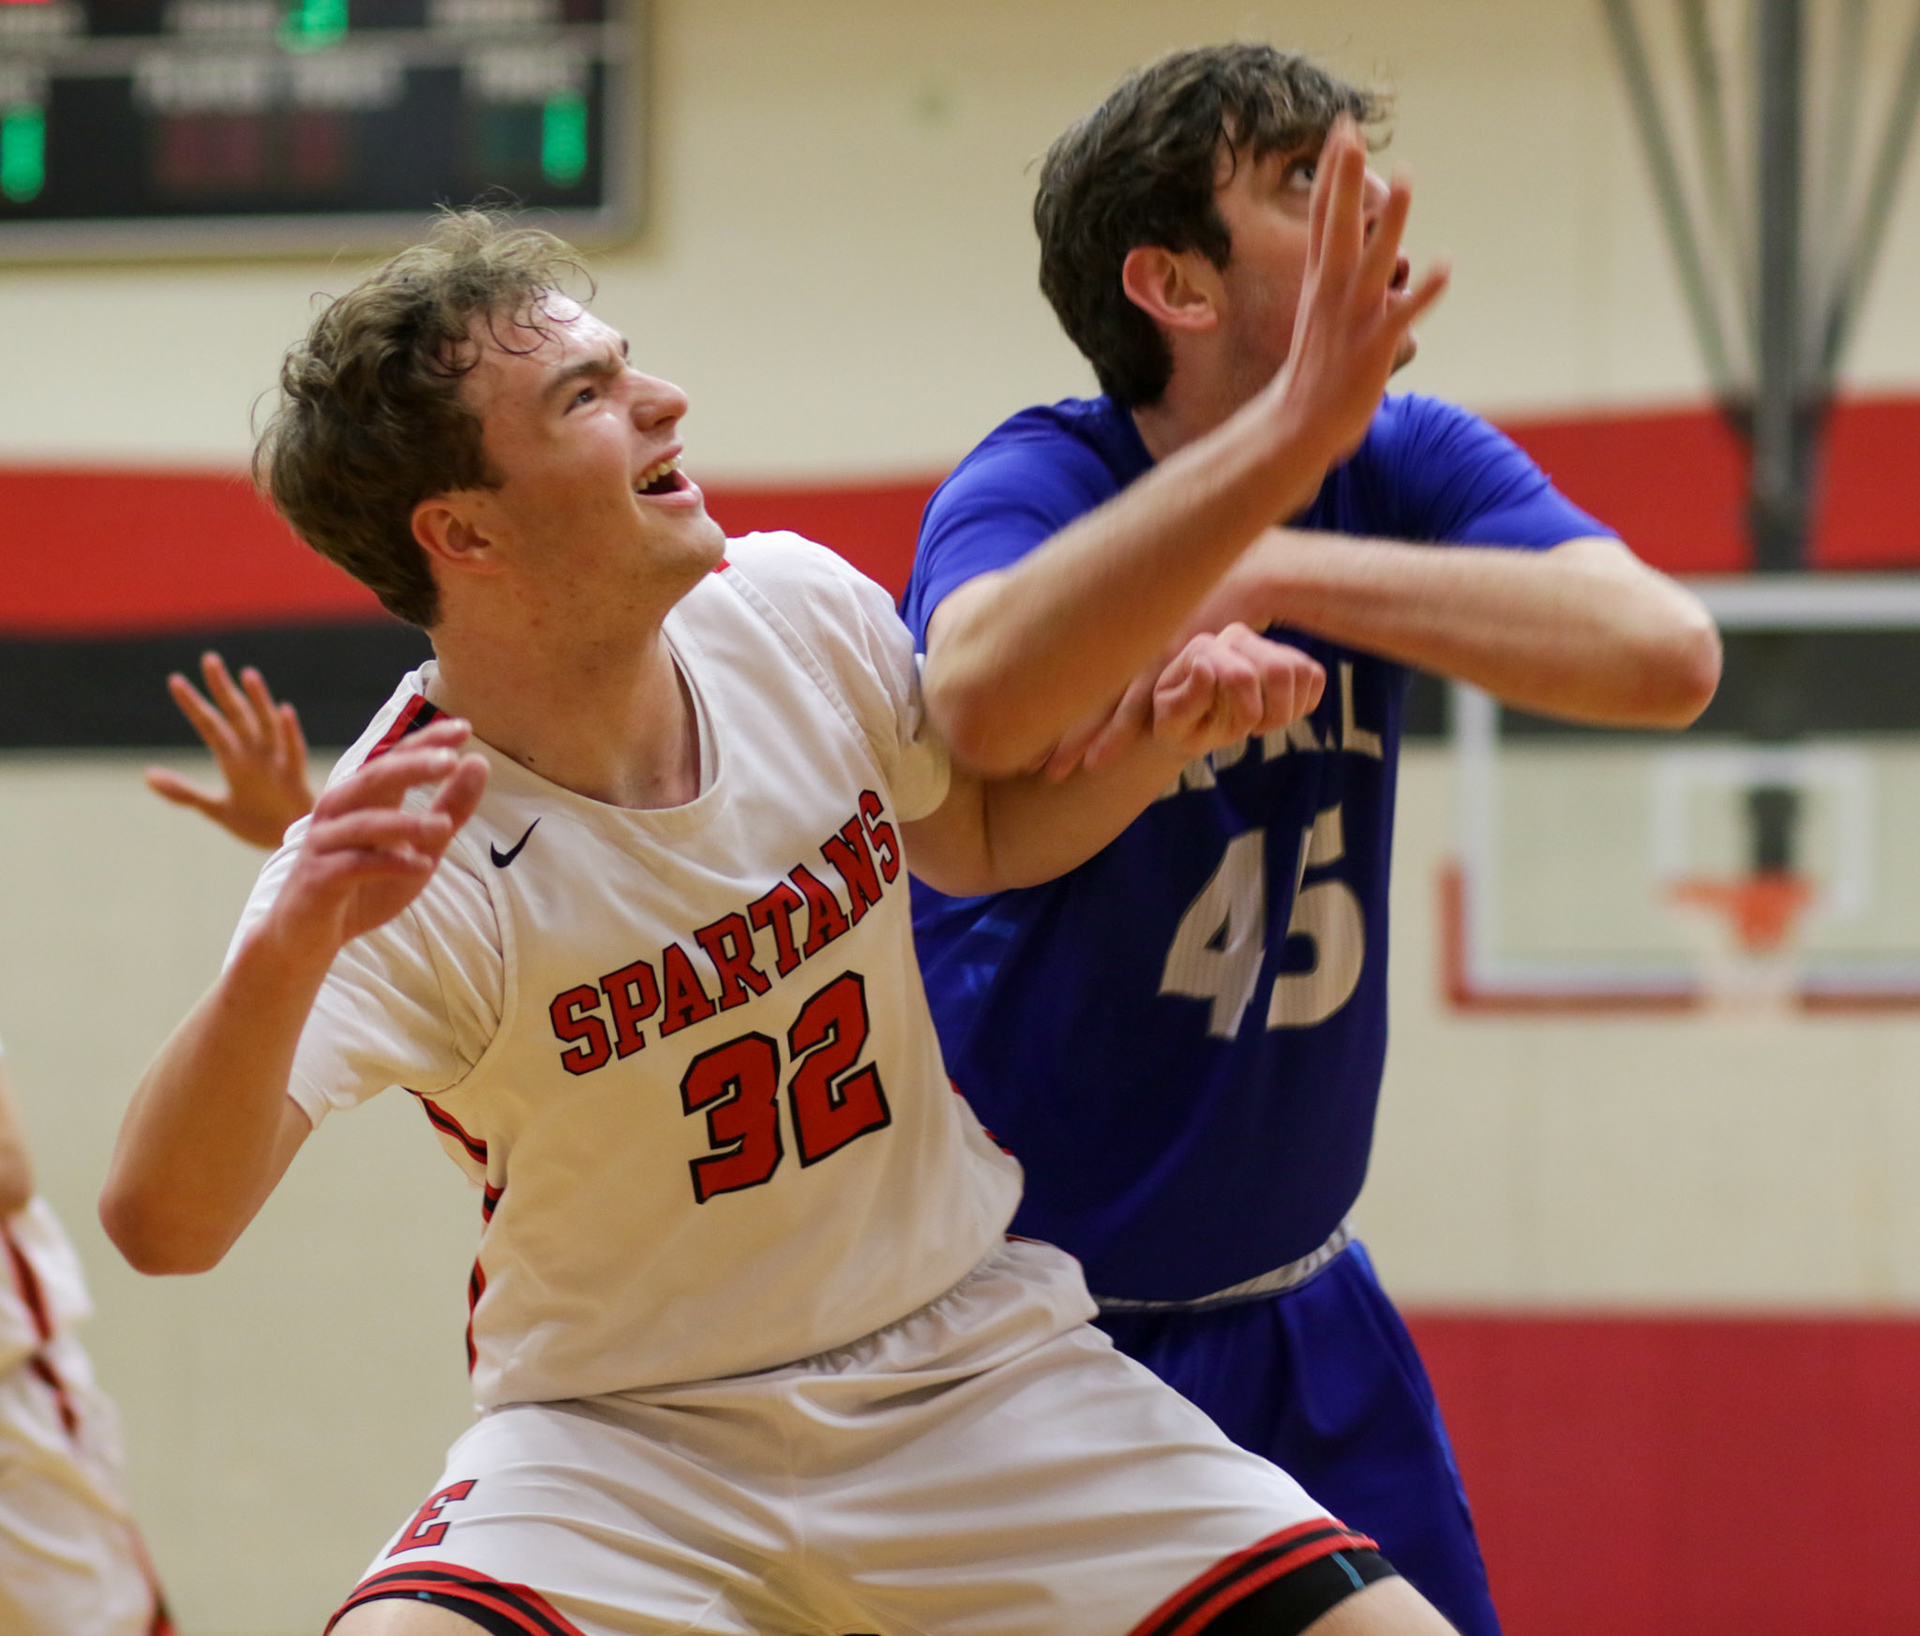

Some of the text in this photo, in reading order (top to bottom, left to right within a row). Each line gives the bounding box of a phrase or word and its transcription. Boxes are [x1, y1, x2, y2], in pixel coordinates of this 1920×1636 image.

[549, 789, 900, 1076] SPARTANS
[1157, 803, 1366, 1040] 45
[679, 970, 892, 1205] 32
[386, 1479, 478, 1559] E
